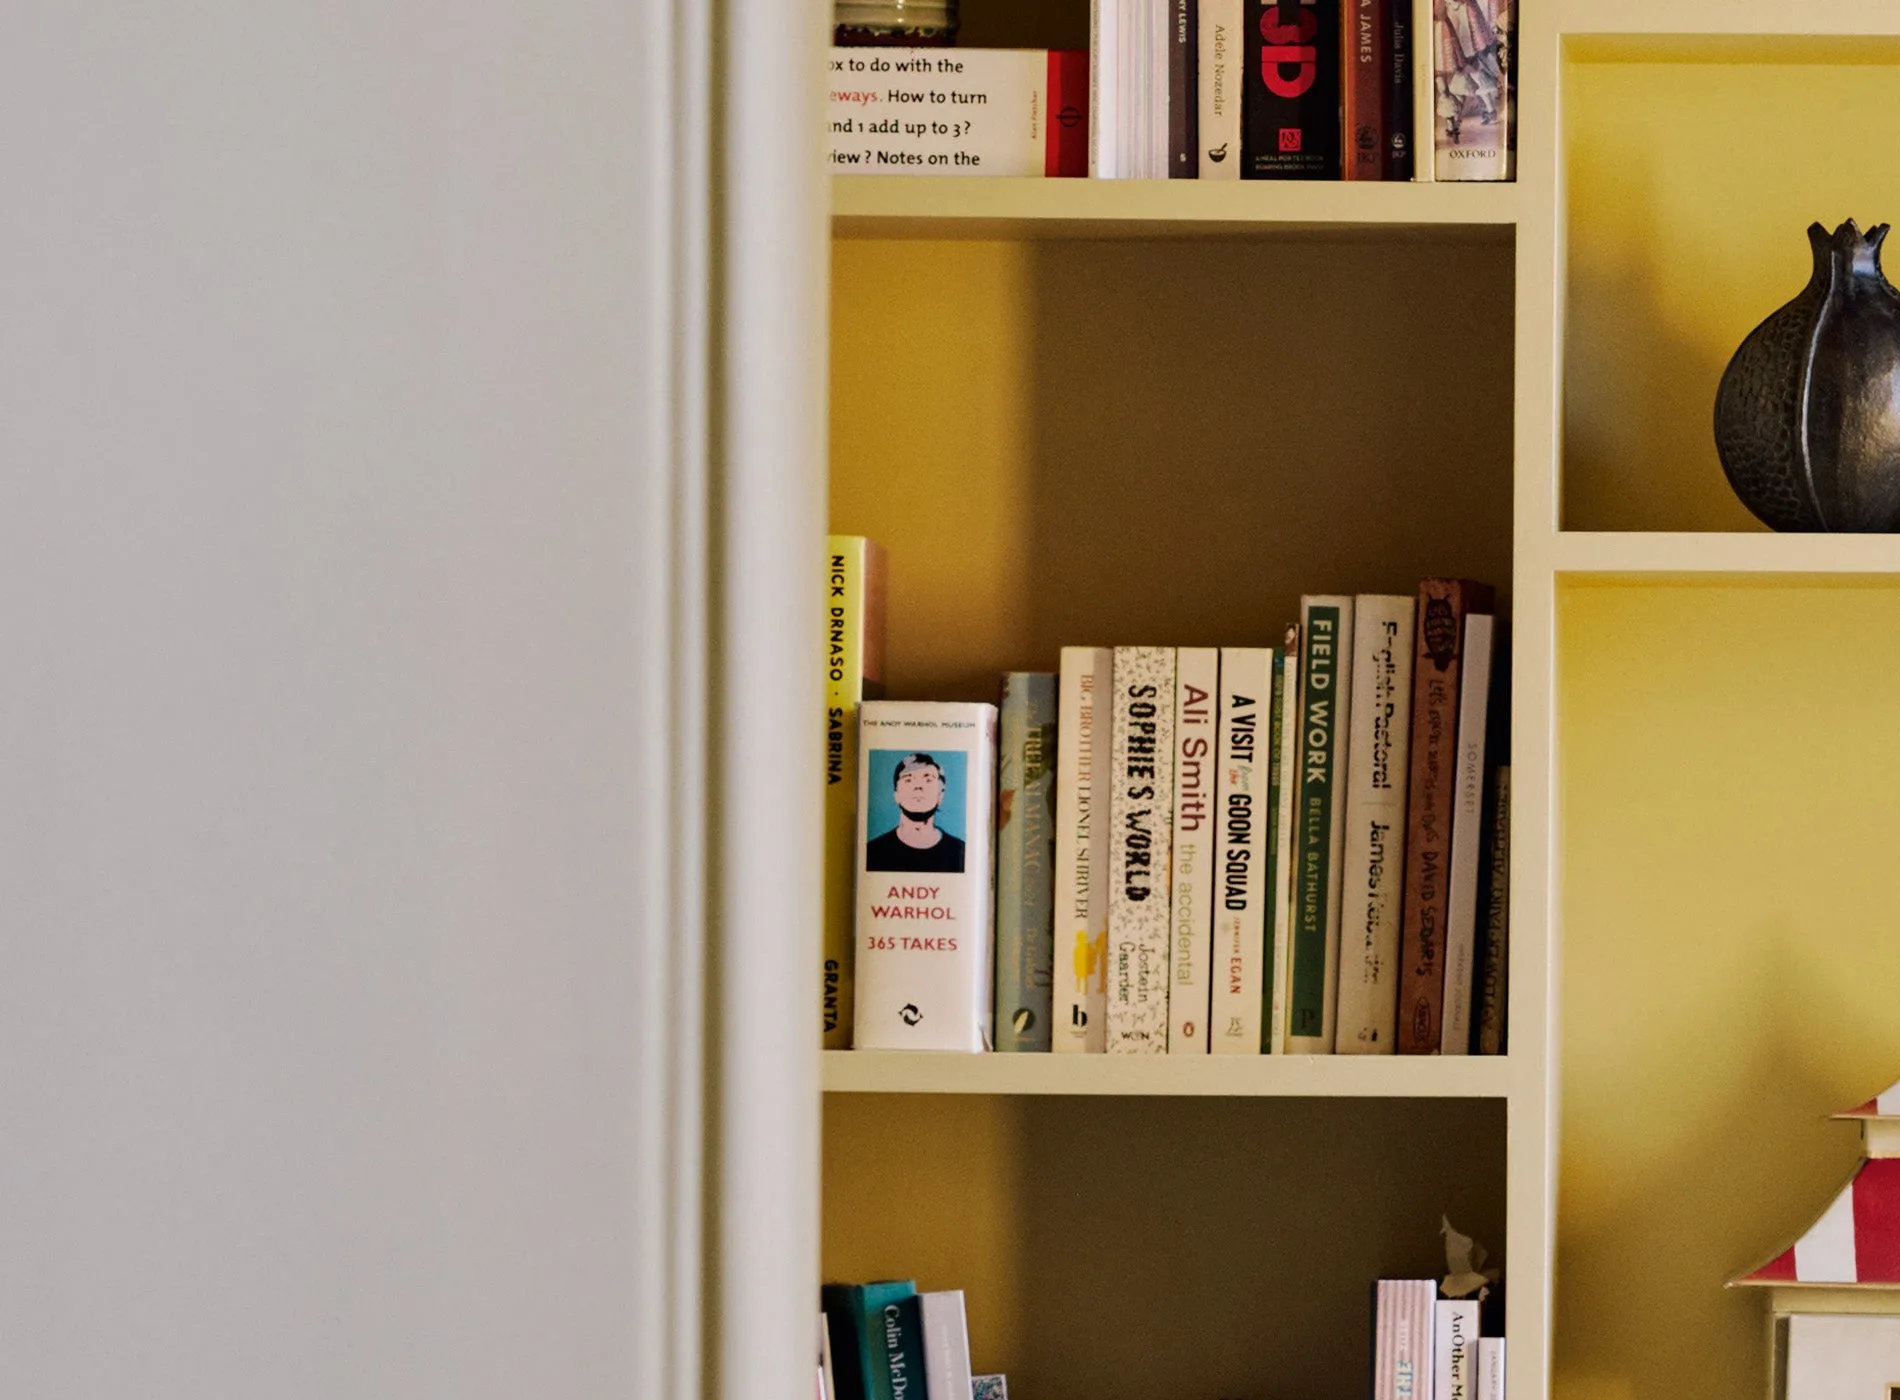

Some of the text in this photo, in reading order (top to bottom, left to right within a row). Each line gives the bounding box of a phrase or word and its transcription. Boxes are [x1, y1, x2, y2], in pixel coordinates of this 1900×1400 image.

[1212, 24, 1227, 117] Adele Nozedar
[1358, 13, 1373, 63] JAMES
[1449, 150, 1497, 161] OXFORD
[826, 555, 846, 786] NICK DRNASO SABRINA
[1074, 674, 1096, 919] BIG BROTHER LIONEL SHRIVER
[1124, 684, 1158, 902] SOPHIE'S WORLD
[1303, 618, 1334, 933] FIELD WORK BELLA BATHURST
[1465, 742, 1479, 816] SOMERSET
[1175, 684, 1211, 986] Ali Smith the accidental
[870, 905, 956, 921] WARHOL
[887, 886, 941, 900] ANDY
[867, 936, 958, 953] 365 TAKES
[1118, 941, 1137, 1004] Gaarder
[1135, 943, 1155, 1004] Jostein
[823, 959, 839, 1034] GRANTA
[882, 1304, 905, 1349] Colin
[1449, 1311, 1465, 1381] AnOther
